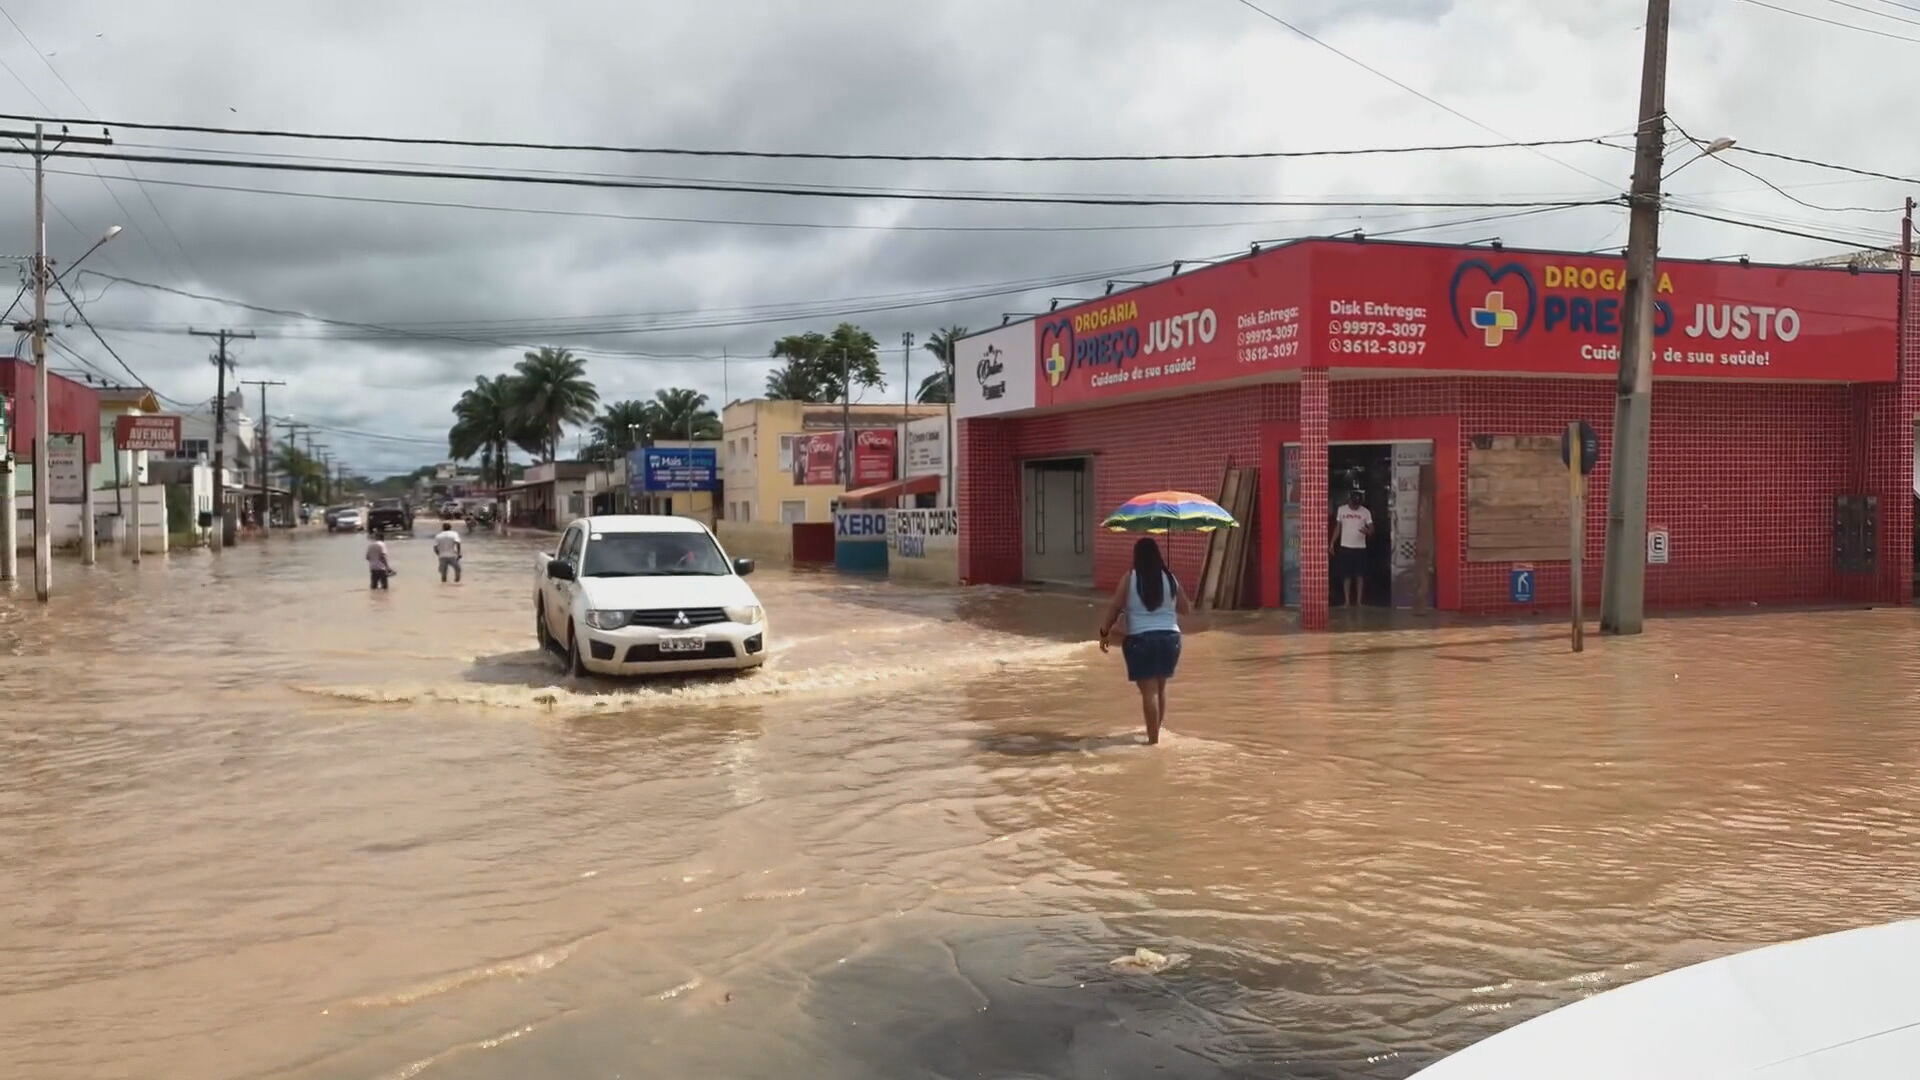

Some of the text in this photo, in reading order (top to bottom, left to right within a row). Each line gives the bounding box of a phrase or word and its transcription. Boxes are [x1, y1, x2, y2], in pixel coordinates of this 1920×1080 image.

[1545, 266, 1674, 294] DROGAA
[1075, 301, 1138, 333] DROGARIA
[1238, 307, 1299, 329] Disk Entrega:
[1330, 301, 1427, 321] Disk Entrega:
[1544, 295, 1800, 342] PREO JUSTO
[1076, 308, 1217, 368] PREÇO JUSTO
[1244, 324, 1299, 345] 99973-3097
[1342, 321, 1426, 337] 99973-3097
[1244, 342, 1299, 363] 3612-3097
[1342, 340, 1426, 355] 3612-3097
[1663, 347, 1682, 362] de
[1687, 351, 1715, 364] sua
[1720, 350, 1770, 366] saúde!
[1091, 357, 1196, 387] Cuidando de sua saúde!
[129, 427, 175, 440] AVENIDA
[837, 513, 886, 536] XERO
[897, 510, 926, 535] CENTRO
[928, 510, 957, 535] COPIAS
